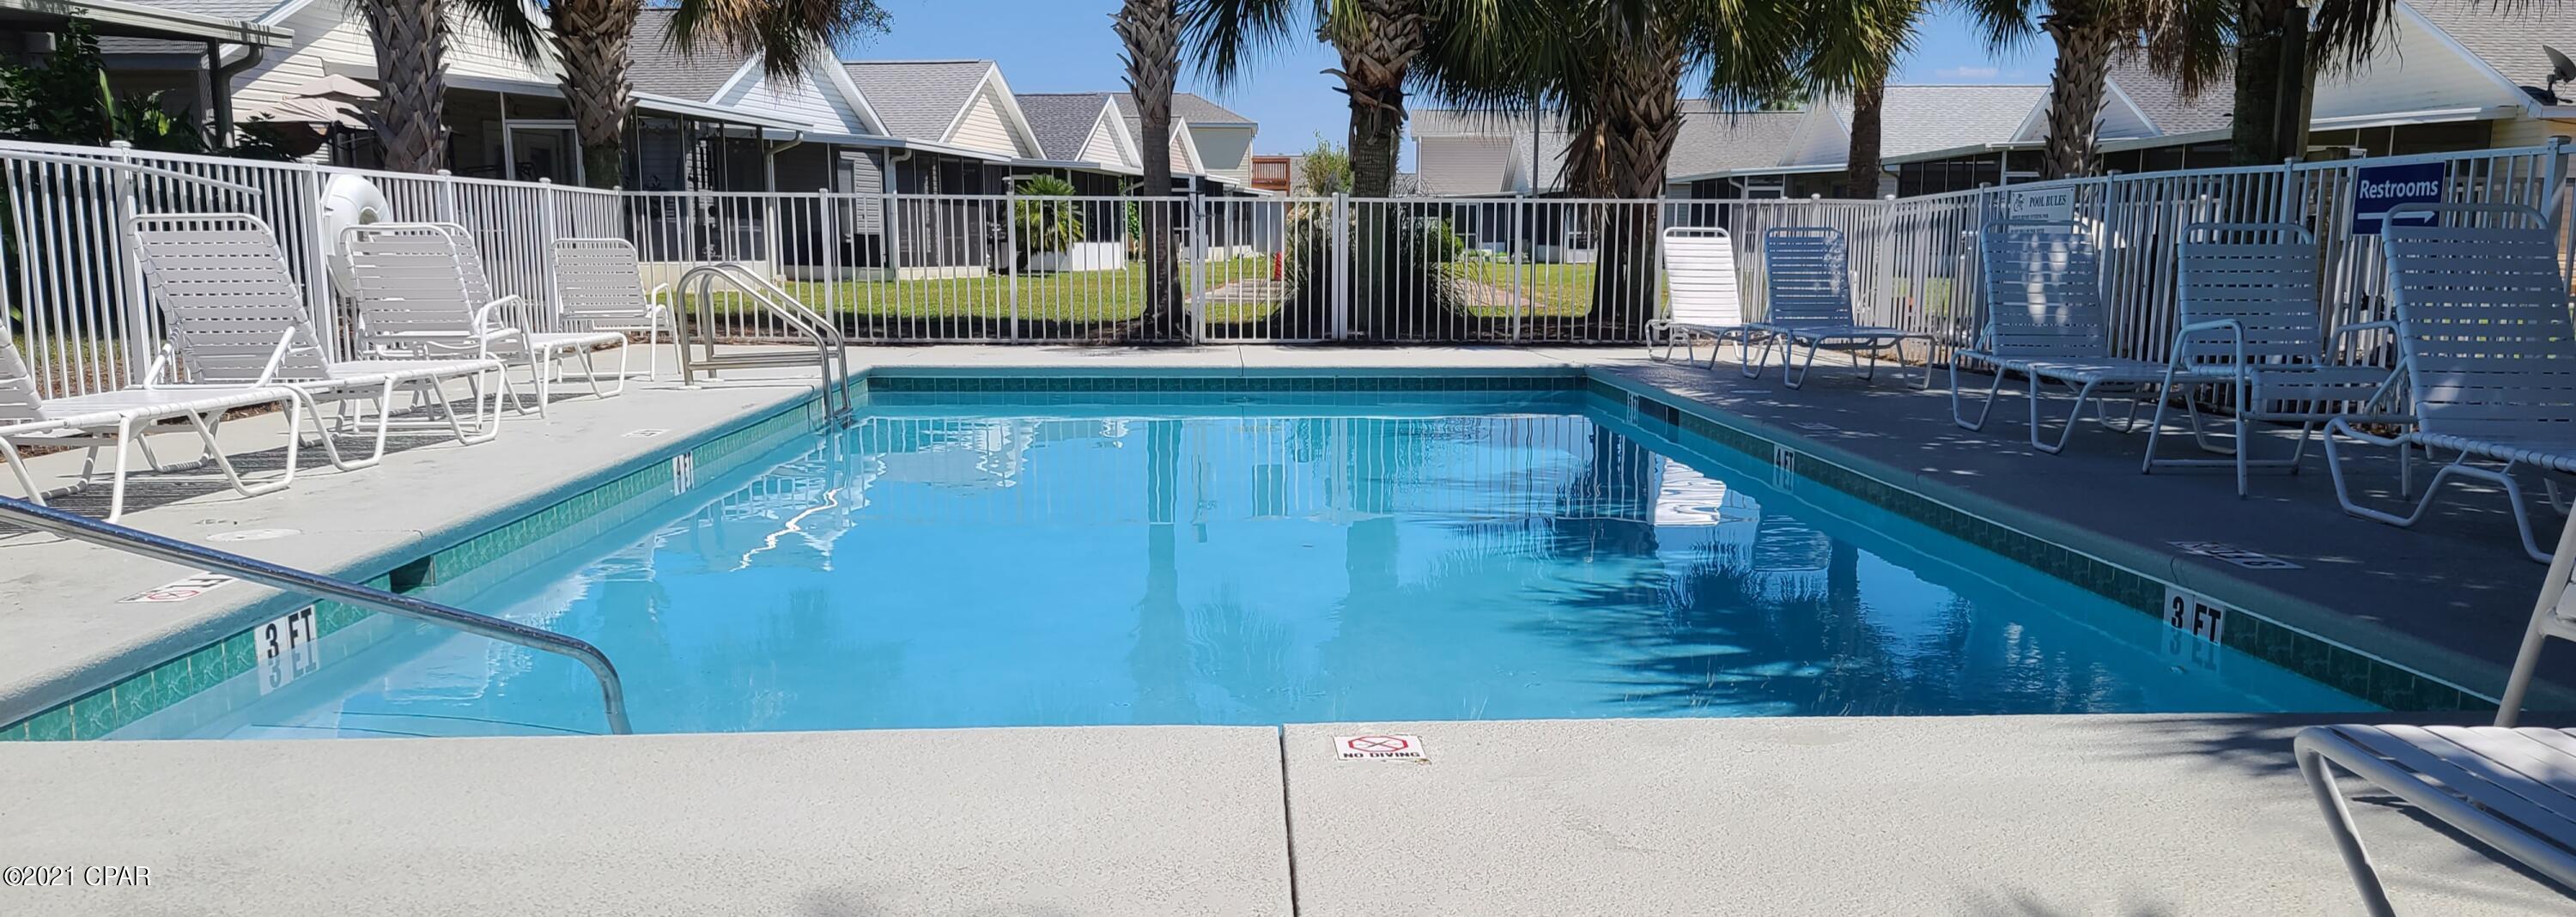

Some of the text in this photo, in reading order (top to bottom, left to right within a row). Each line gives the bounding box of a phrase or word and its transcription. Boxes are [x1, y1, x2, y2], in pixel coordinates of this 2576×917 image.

[2029, 194, 2067, 207] POOL RULES
[2359, 179, 2439, 199] Restrooms
[677, 452, 691, 476] 4 FT
[1776, 448, 1793, 472] 4 FT
[2171, 596, 2221, 642] 3 FT
[265, 608, 312, 659] 3 FT
